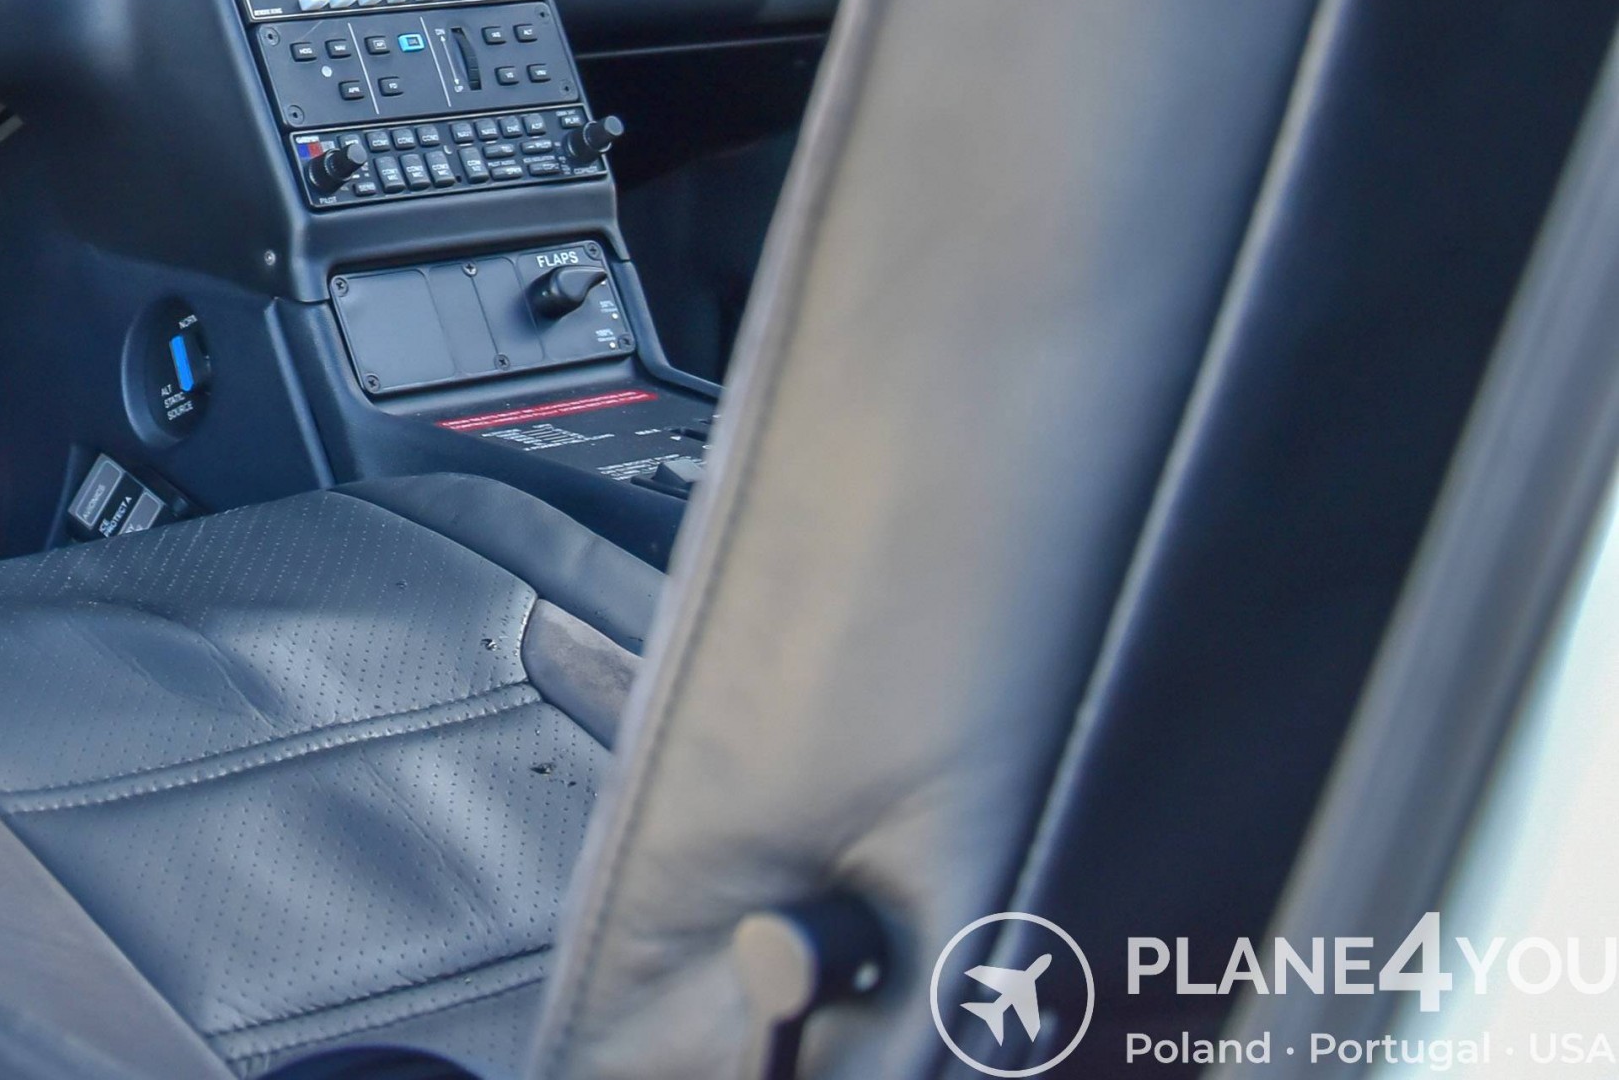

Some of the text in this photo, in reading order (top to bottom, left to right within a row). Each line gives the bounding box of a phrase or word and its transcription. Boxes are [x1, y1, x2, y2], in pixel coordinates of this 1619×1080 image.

[536, 251, 578, 268] FLAPS
[179, 315, 198, 329] NORM
[161, 384, 173, 396] ALT
[164, 392, 185, 409] STATIC
[167, 400, 194, 420] SOURCE
